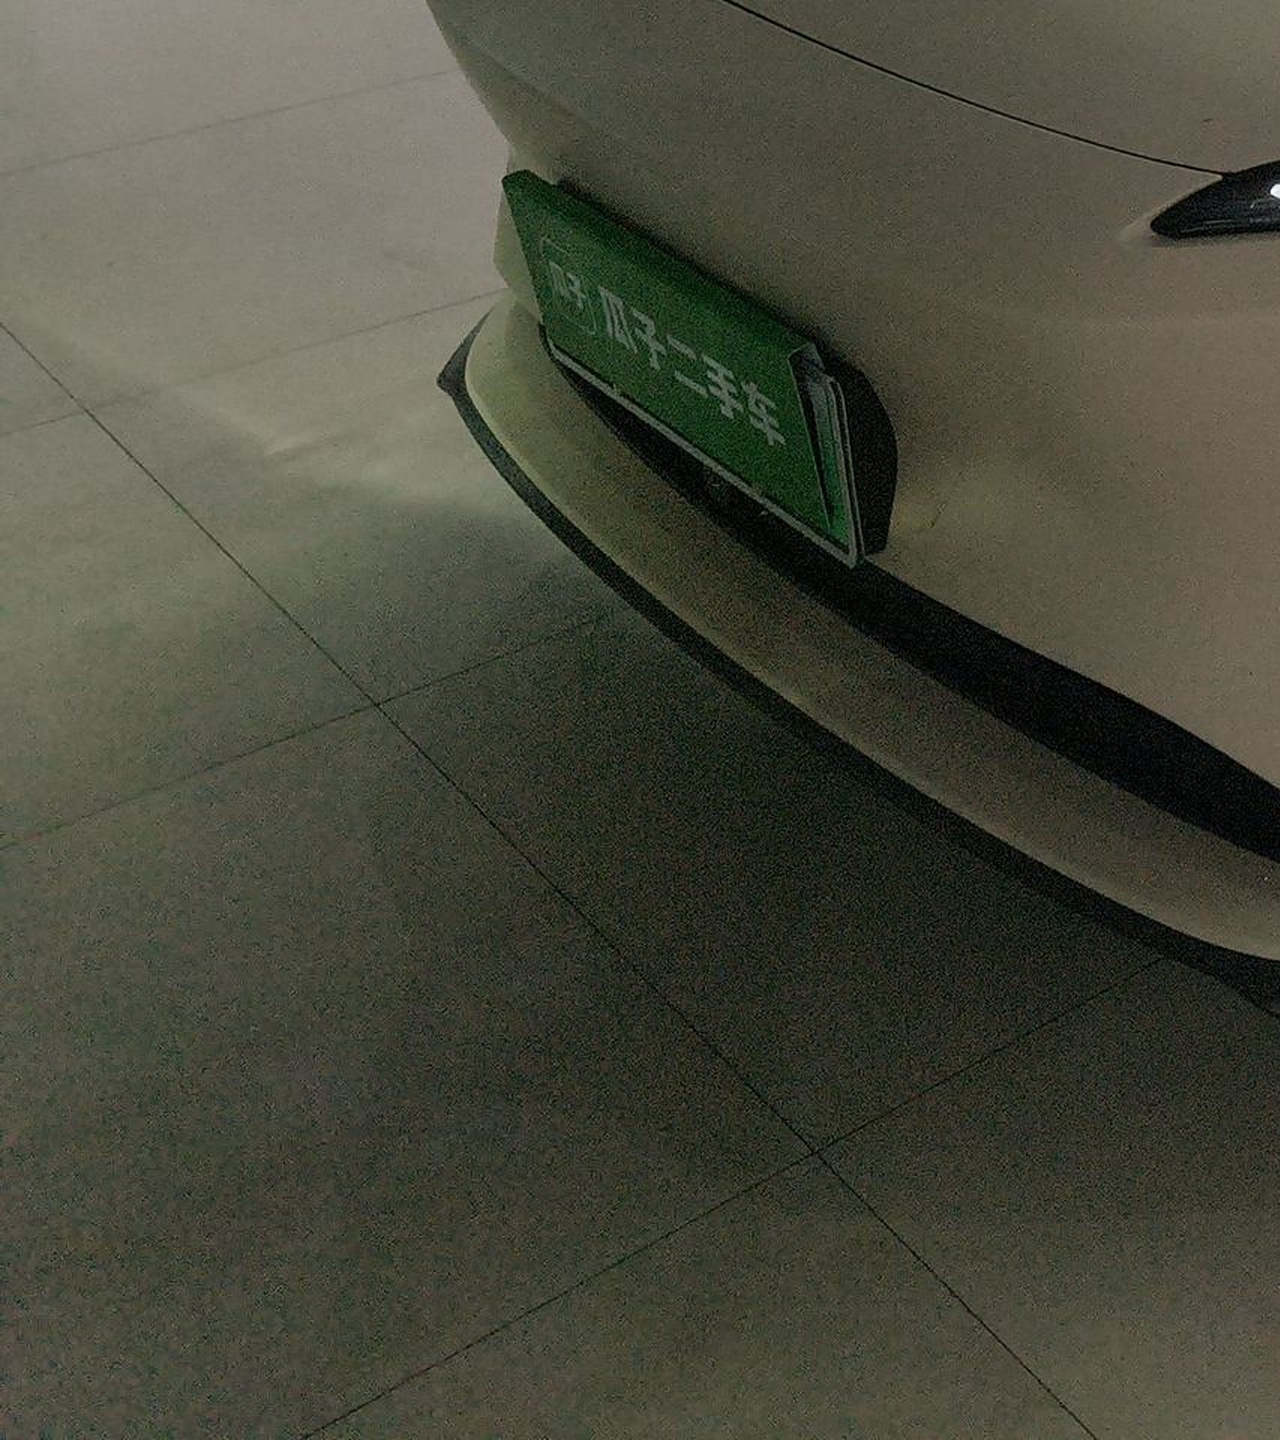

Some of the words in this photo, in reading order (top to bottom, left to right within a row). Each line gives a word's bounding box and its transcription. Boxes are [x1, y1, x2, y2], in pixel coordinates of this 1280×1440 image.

[600, 287, 786, 446] 瓜子二手车
